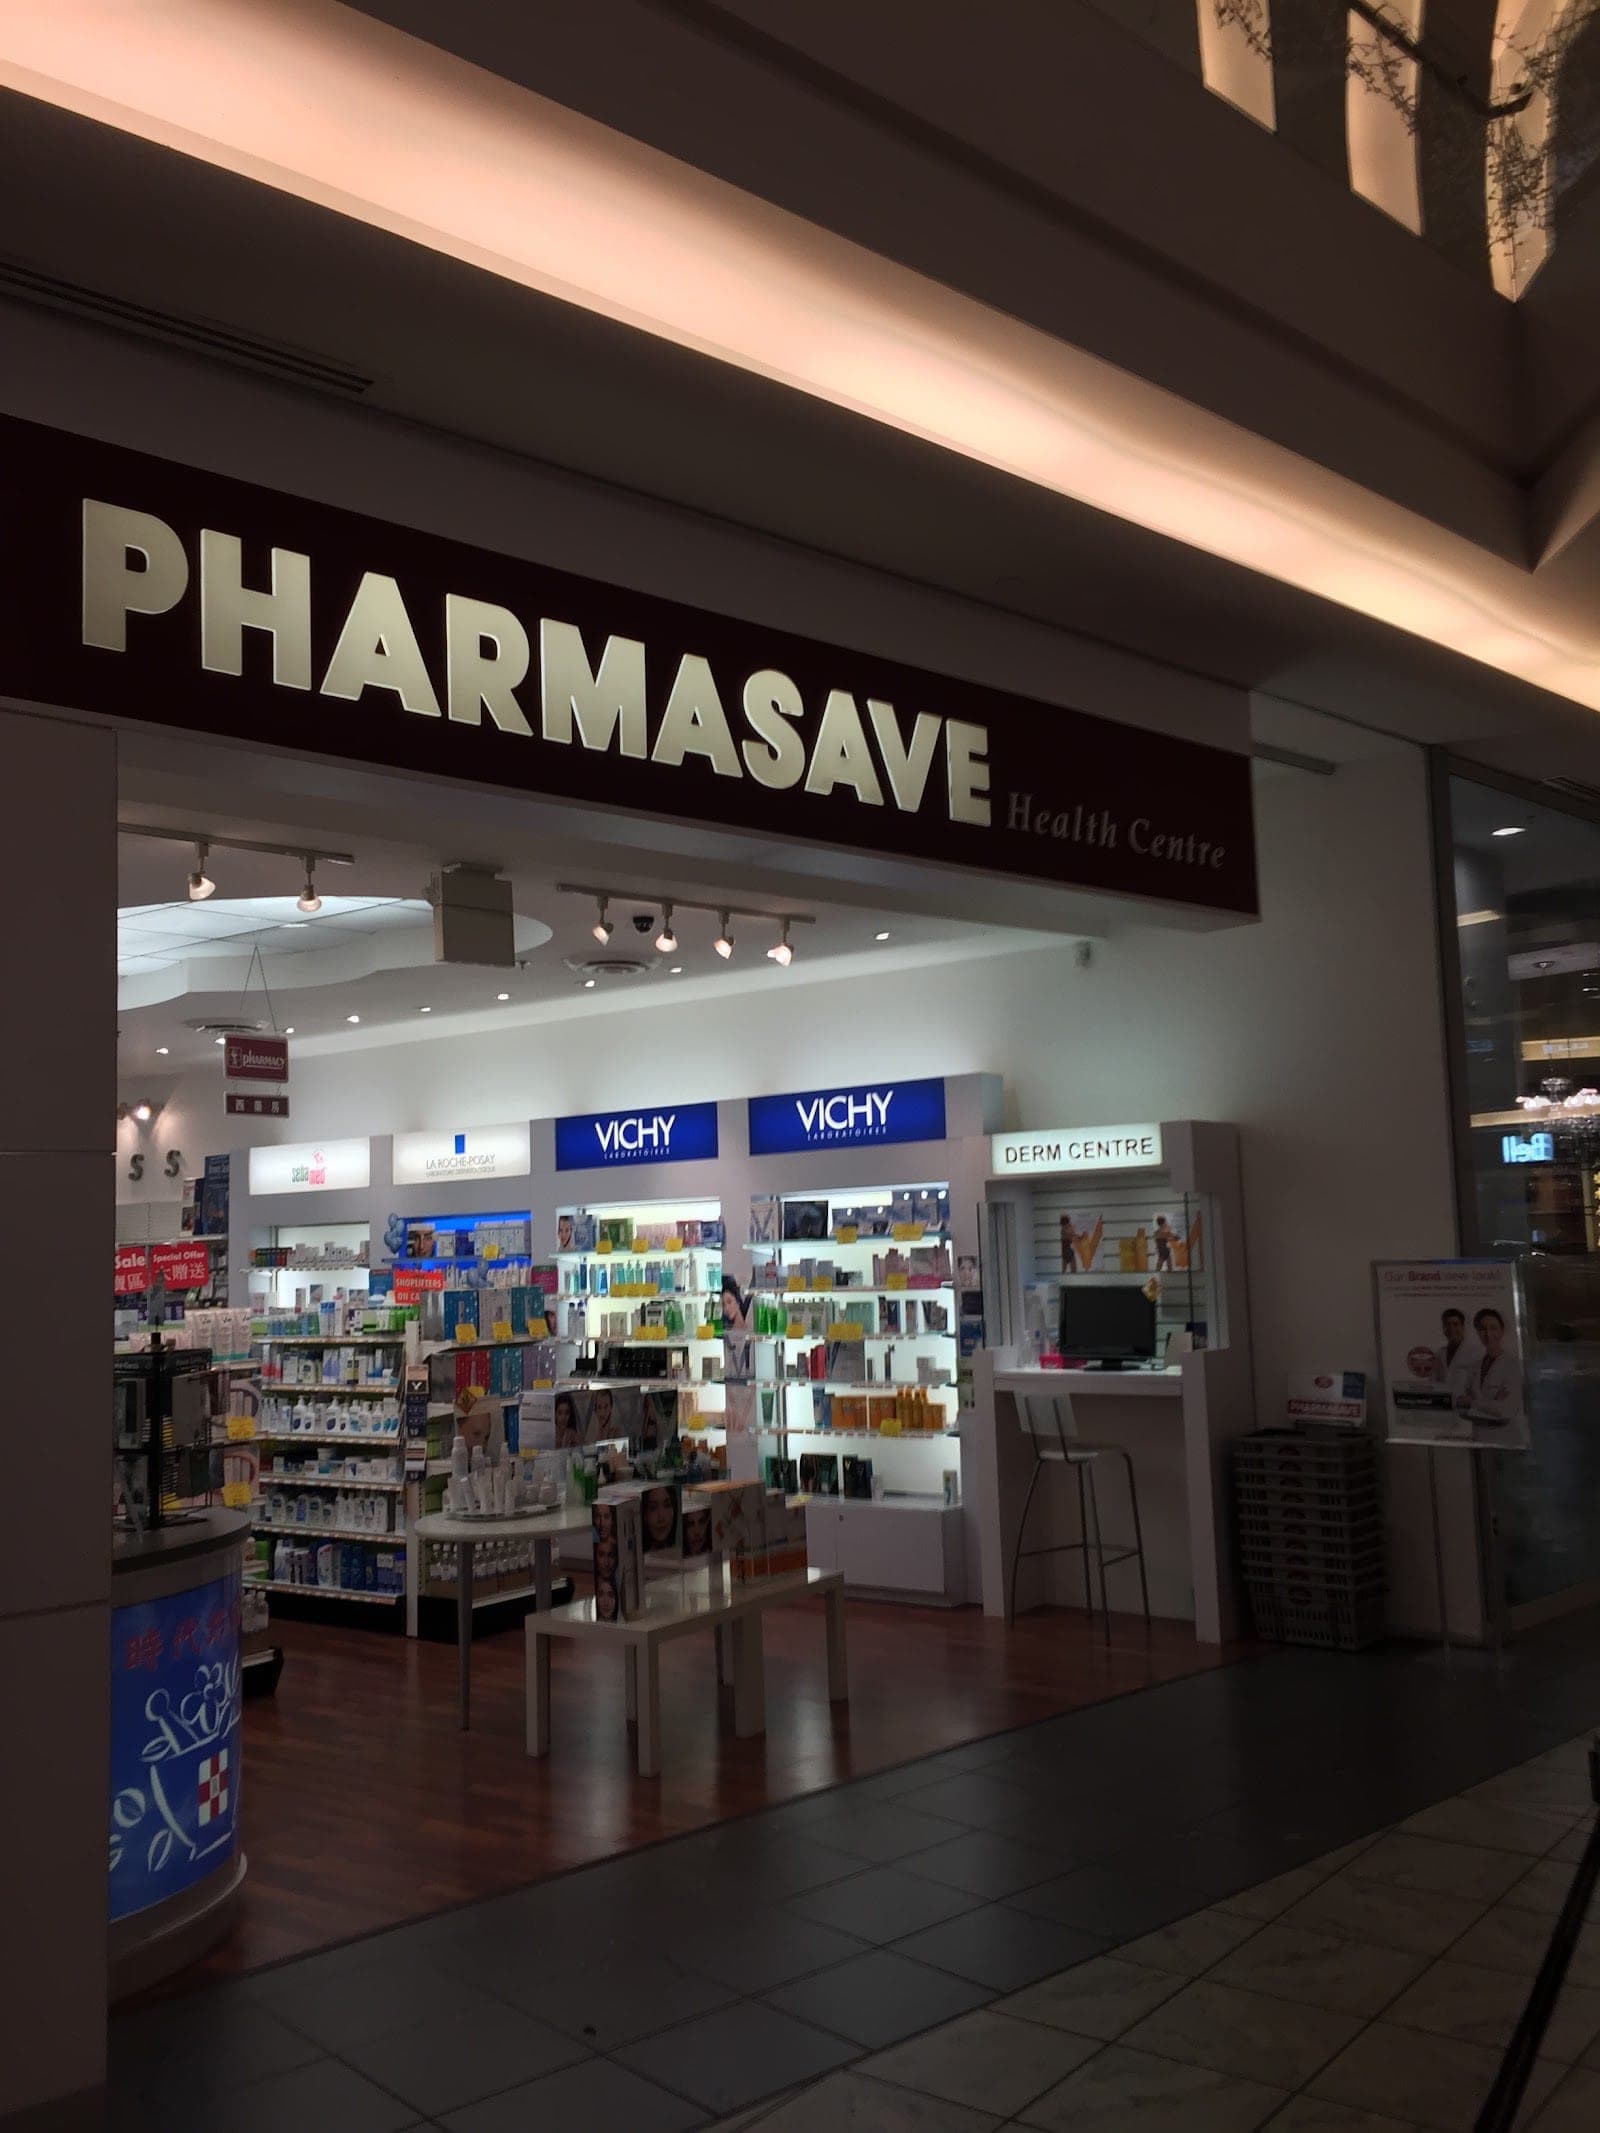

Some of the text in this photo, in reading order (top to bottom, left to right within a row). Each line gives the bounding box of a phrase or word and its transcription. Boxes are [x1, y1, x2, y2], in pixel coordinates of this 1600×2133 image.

[82, 498, 990, 828] PHARMASAVE
[1005, 791, 1226, 869] Health Centre
[795, 1090, 893, 1133] VICHY
[595, 1114, 676, 1152] VICHY
[1005, 1137, 1154, 1164] DERM CENTRE
[115, 1253, 145, 1269] Sale
[153, 1251, 182, 1263] Special
[1408, 1270, 1441, 1281] Brand
